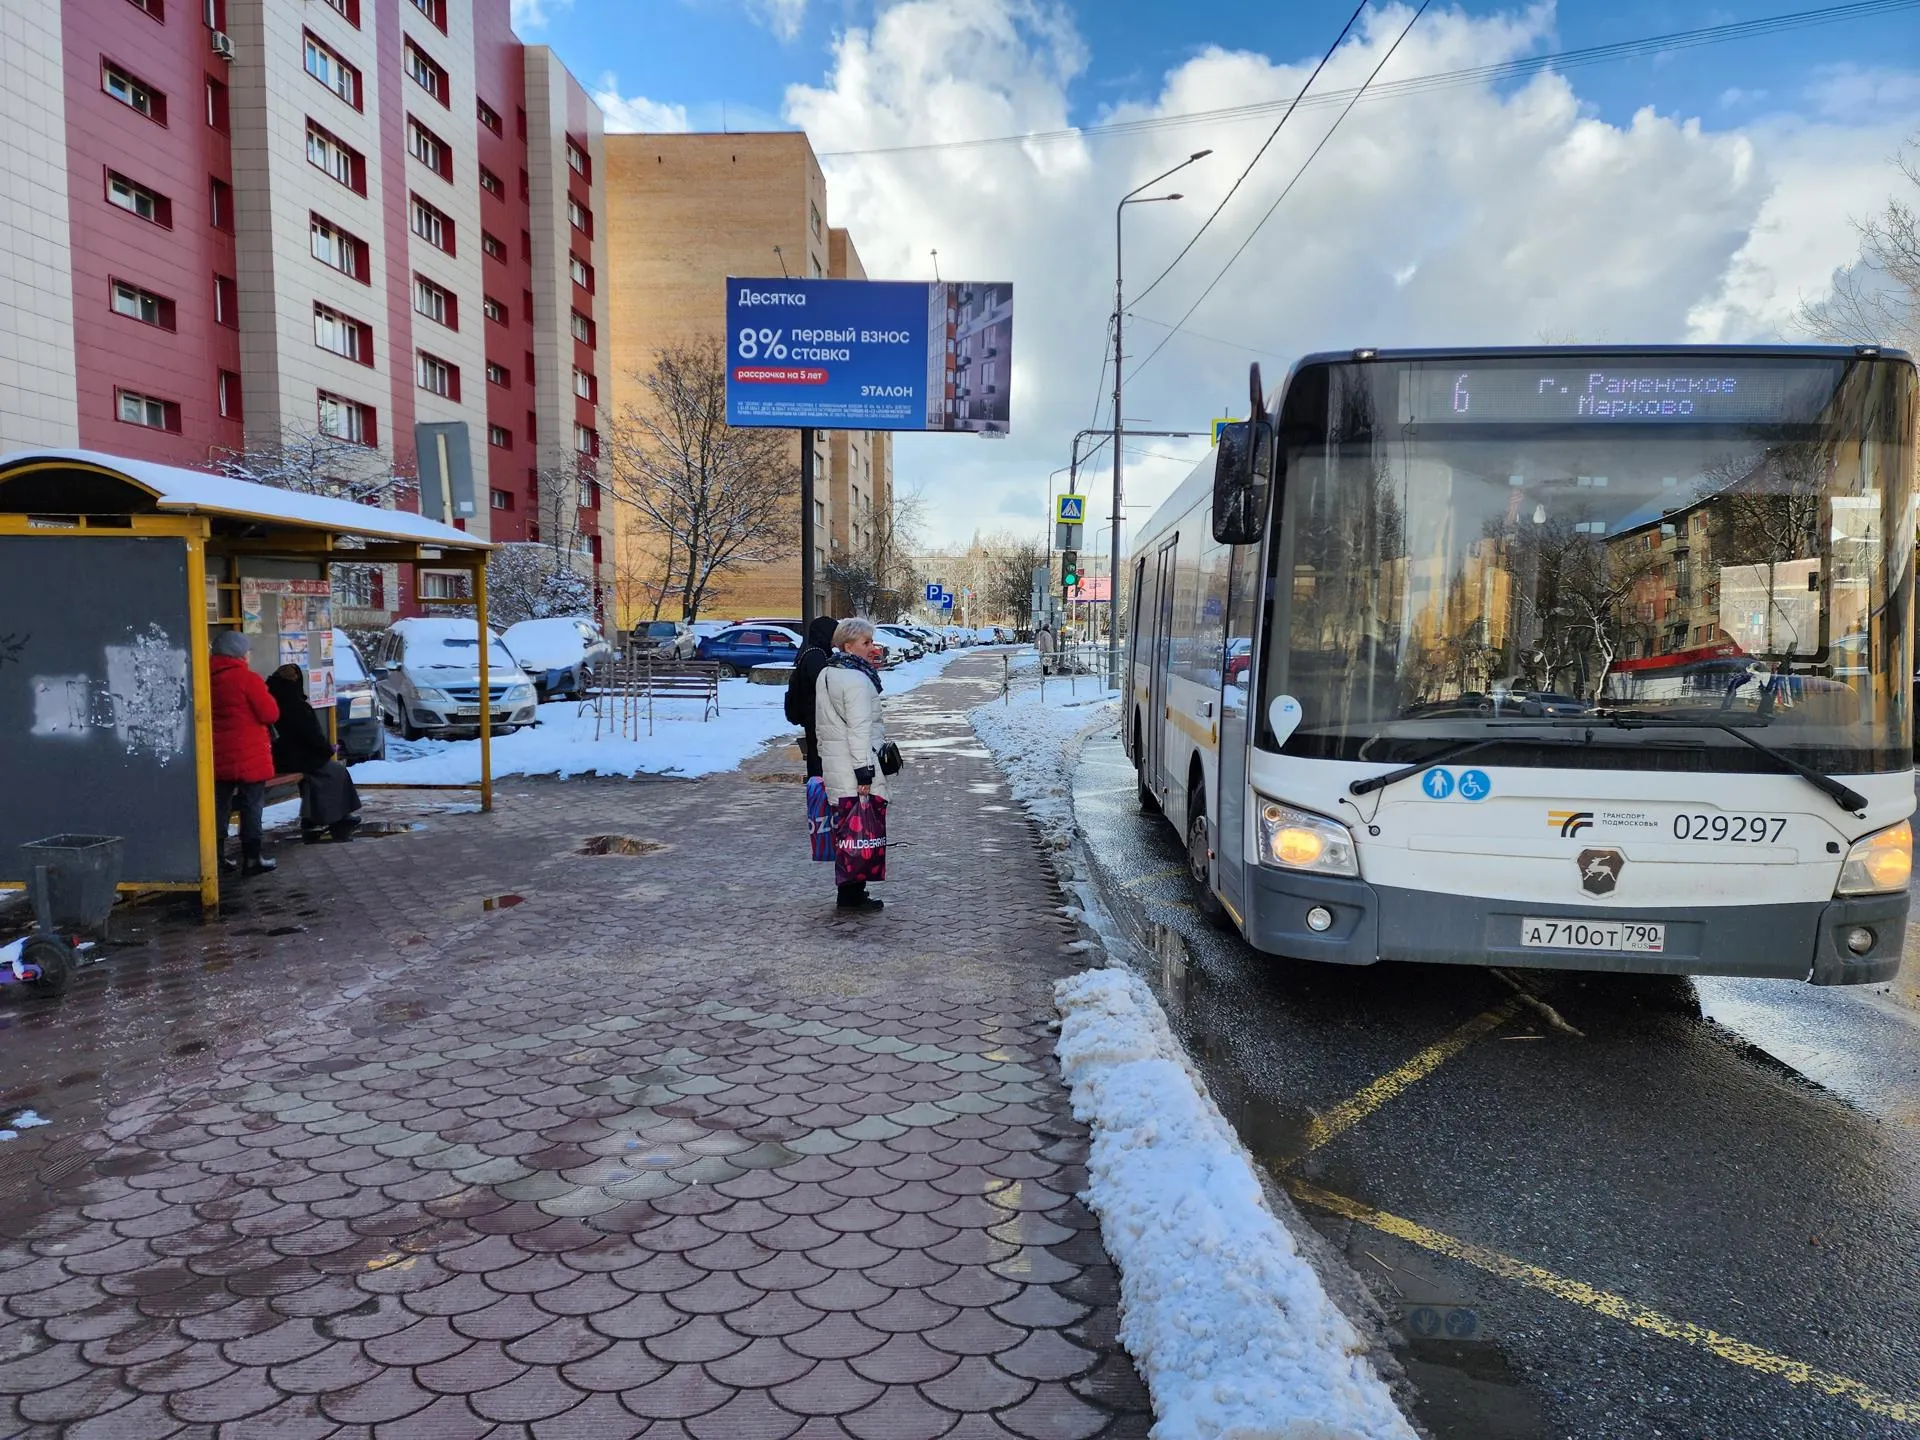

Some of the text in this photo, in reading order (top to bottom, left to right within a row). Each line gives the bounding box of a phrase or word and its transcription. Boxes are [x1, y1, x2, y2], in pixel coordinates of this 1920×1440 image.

[738, 289, 806, 307] Десятка
[738, 328, 788, 359] 8%
[791, 327, 910, 345] первый взнос
[791, 346, 850, 361] ставка
[738, 370, 822, 380] рассрочка на 5 лет
[1538, 373, 1738, 395] г. Раменское
[860, 385, 913, 398] ЭТАЛОН
[1453, 374, 1470, 413] 6
[1577, 395, 1694, 417] Марково
[929, 586, 939, 599] P
[1602, 819, 1658, 827] ПОДМОСКОВЬЯ
[1673, 814, 1788, 843] 029297
[1624, 926, 1658, 942] 790
